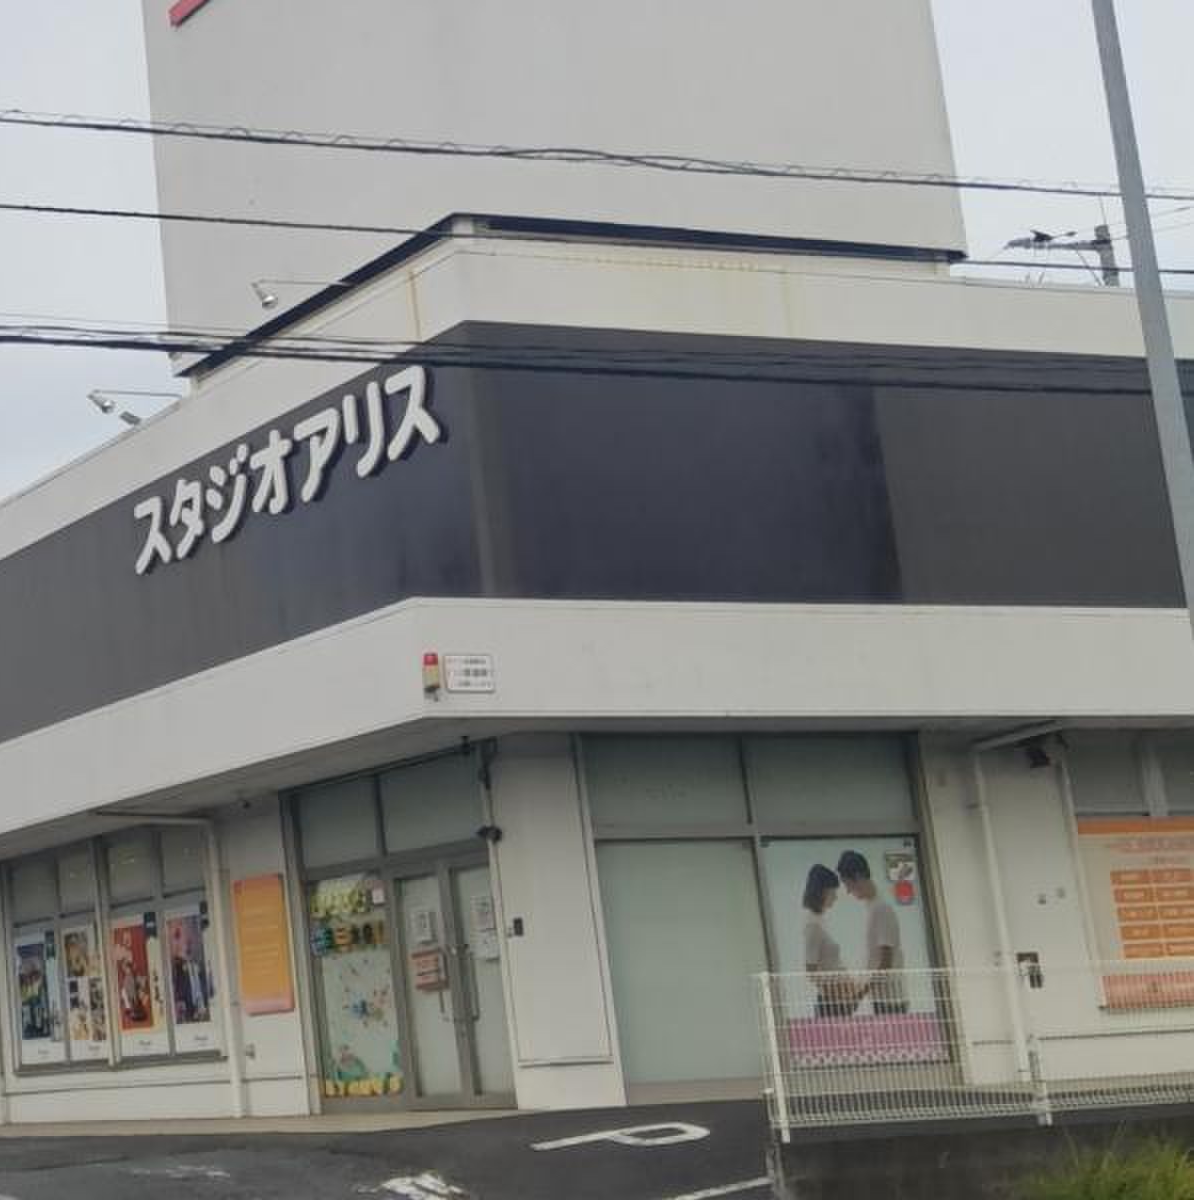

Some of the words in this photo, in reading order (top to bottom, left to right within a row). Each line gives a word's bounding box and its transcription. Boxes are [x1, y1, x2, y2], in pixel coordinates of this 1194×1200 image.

[133, 364, 441, 576] スタジオアリス
